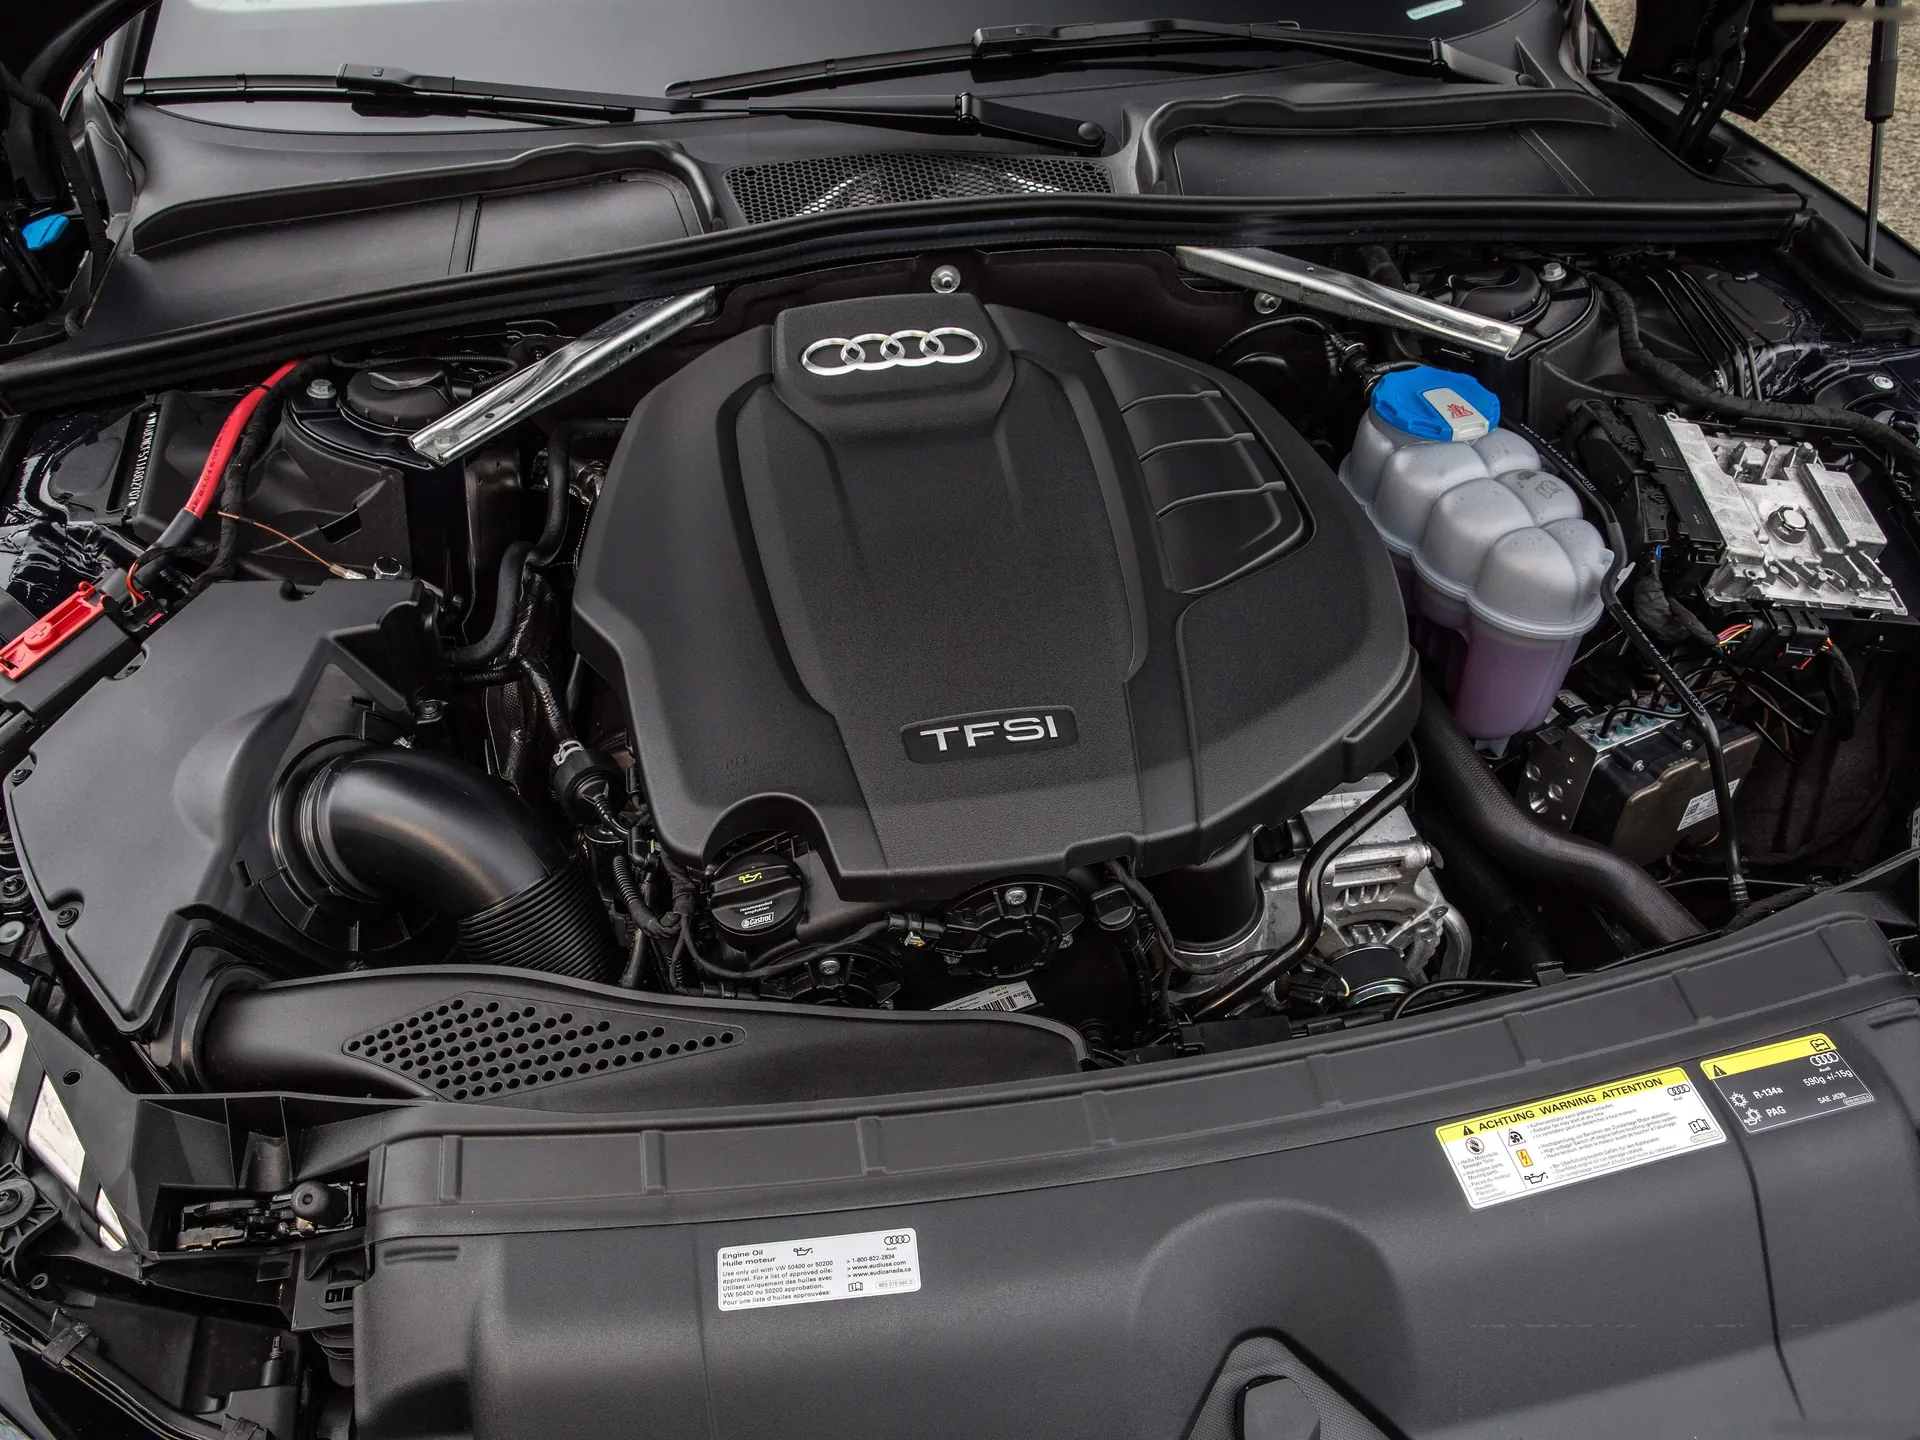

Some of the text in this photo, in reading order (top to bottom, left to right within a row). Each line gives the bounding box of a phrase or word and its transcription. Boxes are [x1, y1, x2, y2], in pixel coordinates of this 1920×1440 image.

[920, 716, 1058, 751] TFSI
[740, 900, 772, 911] recommended
[750, 915, 771, 925] Castrol
[1803, 1069, 1853, 1087] 590g +/-15g
[1753, 1087, 1783, 1099] R-134a
[1832, 1092, 1846, 1101] J639
[1479, 1077, 1663, 1131] ACHTUNG WARNING ATTENTION
[1766, 1106, 1786, 1117] PAG
[1608, 1152, 1626, 1160] damage
[745, 1257, 776, 1265] moteur
[852, 1254, 895, 1263] 1-800-822-2834
[852, 1260, 906, 1270] www.audiusa.com
[723, 1276, 751, 1284] approval.
[790, 1269, 818, 1278] approved
[853, 1267, 911, 1277] www.audicanada.ca
[747, 1280, 783, 1289] uniquement
[785, 1284, 824, 1292] approbation.
